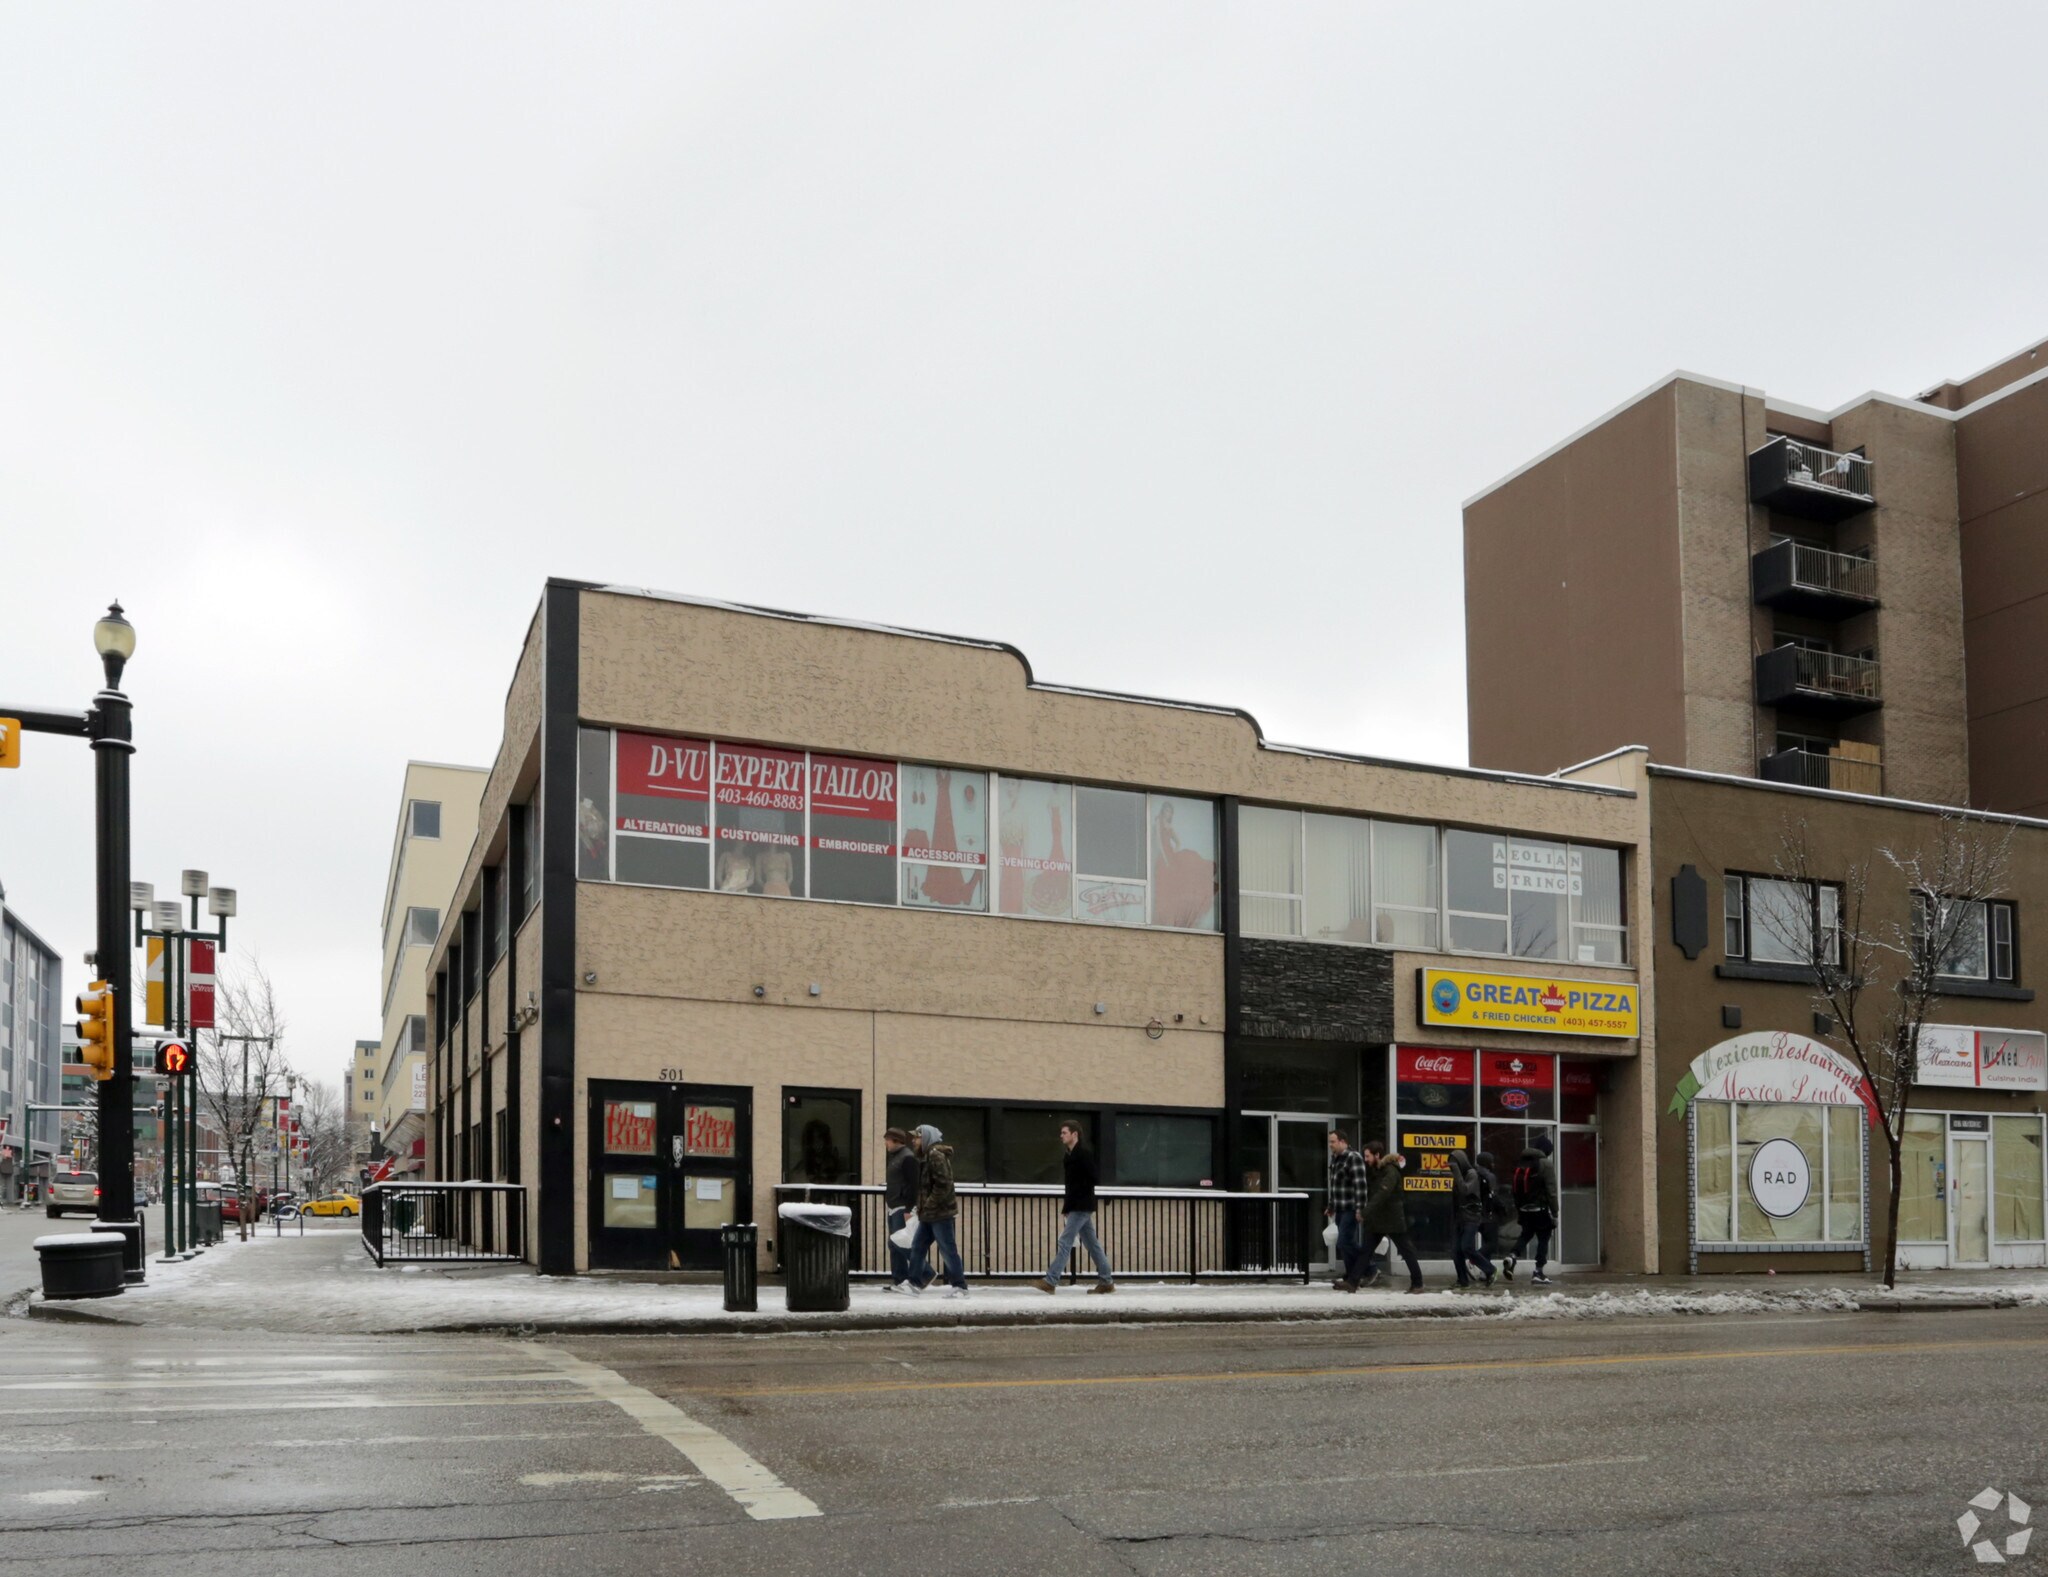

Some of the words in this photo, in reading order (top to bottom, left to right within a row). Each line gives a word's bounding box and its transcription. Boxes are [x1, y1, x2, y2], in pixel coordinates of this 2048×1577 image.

[648, 745, 708, 782] D-VU
[716, 753, 805, 792] EXPERT
[812, 763, 894, 802] TAILOR
[716, 787, 804, 811] 403-460-8883
[623, 818, 703, 837] ALTERATIONS
[720, 828, 800, 846] CUSTOMIZING
[818, 838, 890, 855] EMBROIDERY
[907, 847, 981, 864] ACCESSORIES
[1495, 848, 1580, 865] AEOLIAN
[999, 856, 1041, 870] EVENING
[1042, 859, 1072, 873] GOWN
[1496, 873, 1580, 889] STRINGS
[1465, 982, 1541, 1007] GREAT
[1568, 990, 1633, 1014] PIZZA
[1471, 1010, 1480, 1020] &
[1482, 1011, 1511, 1022] FRIED
[1513, 1013, 1557, 1025] CHICKEN
[1563, 1017, 1586, 1029] (403)
[1588, 1018, 1628, 1029] 457-5557
[1702, 1044, 1771, 1084] Mexican
[1768, 1031, 1863, 1091] Restaurant
[658, 1068, 685, 1081] 501
[1986, 1074, 2016, 1083] Cuisine
[2017, 1075, 2039, 1084] India
[1708, 1069, 1783, 1102] Mexico
[1413, 1135, 1456, 1147] DONAIR
[1405, 1178, 1430, 1189] PIZZA
[1431, 1179, 1443, 1189] BY
[1763, 1171, 1797, 1185] RAD
